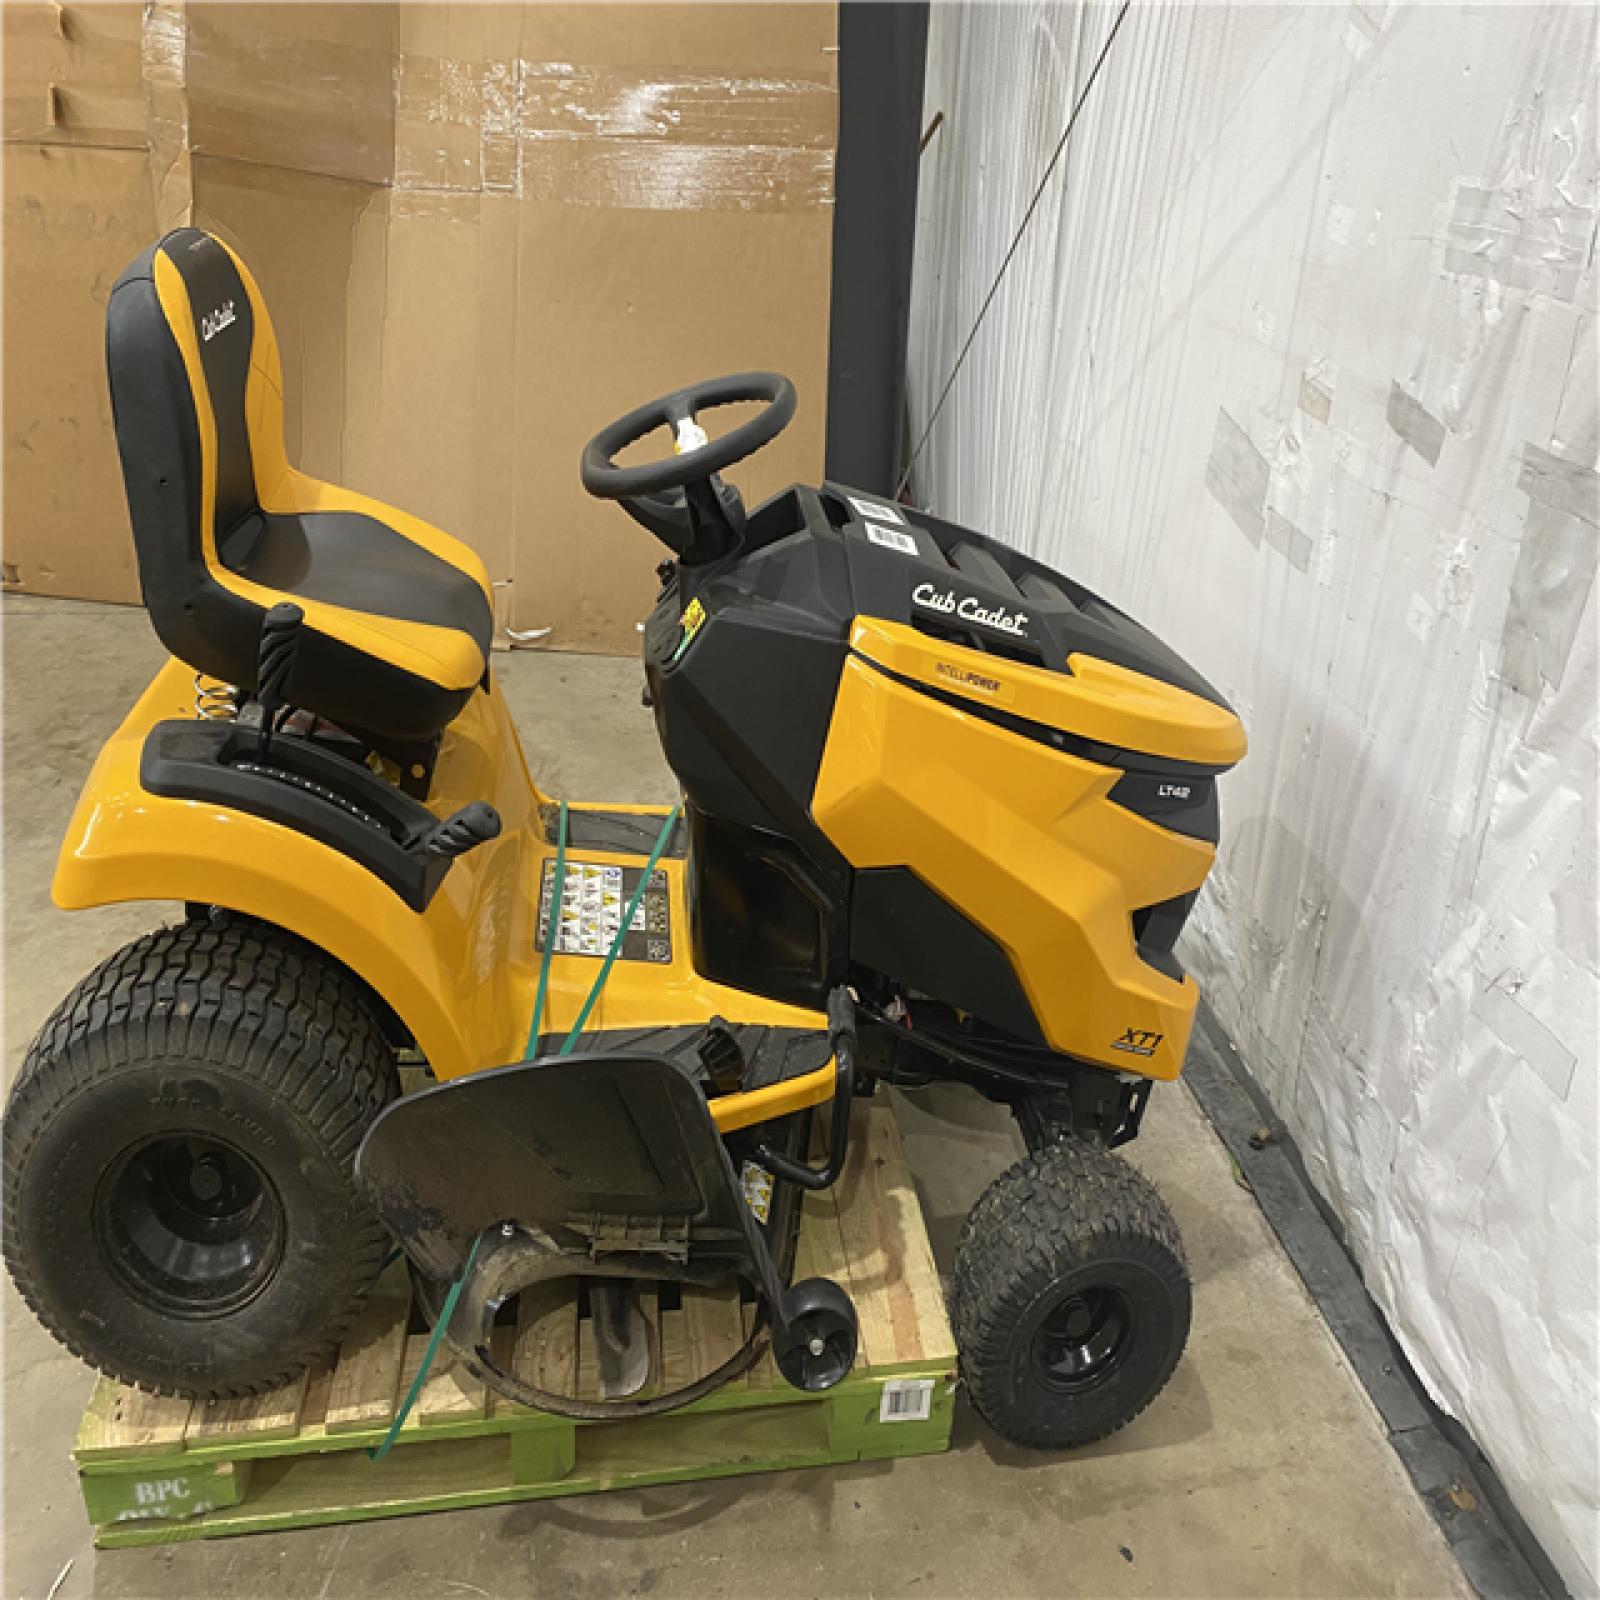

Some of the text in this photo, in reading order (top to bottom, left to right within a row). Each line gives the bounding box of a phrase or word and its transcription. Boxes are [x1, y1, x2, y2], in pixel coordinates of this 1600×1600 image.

[912, 583, 1028, 636] Cub Cadet
[1119, 1027, 1164, 1048] XT1
[135, 1478, 191, 1505] BPC
